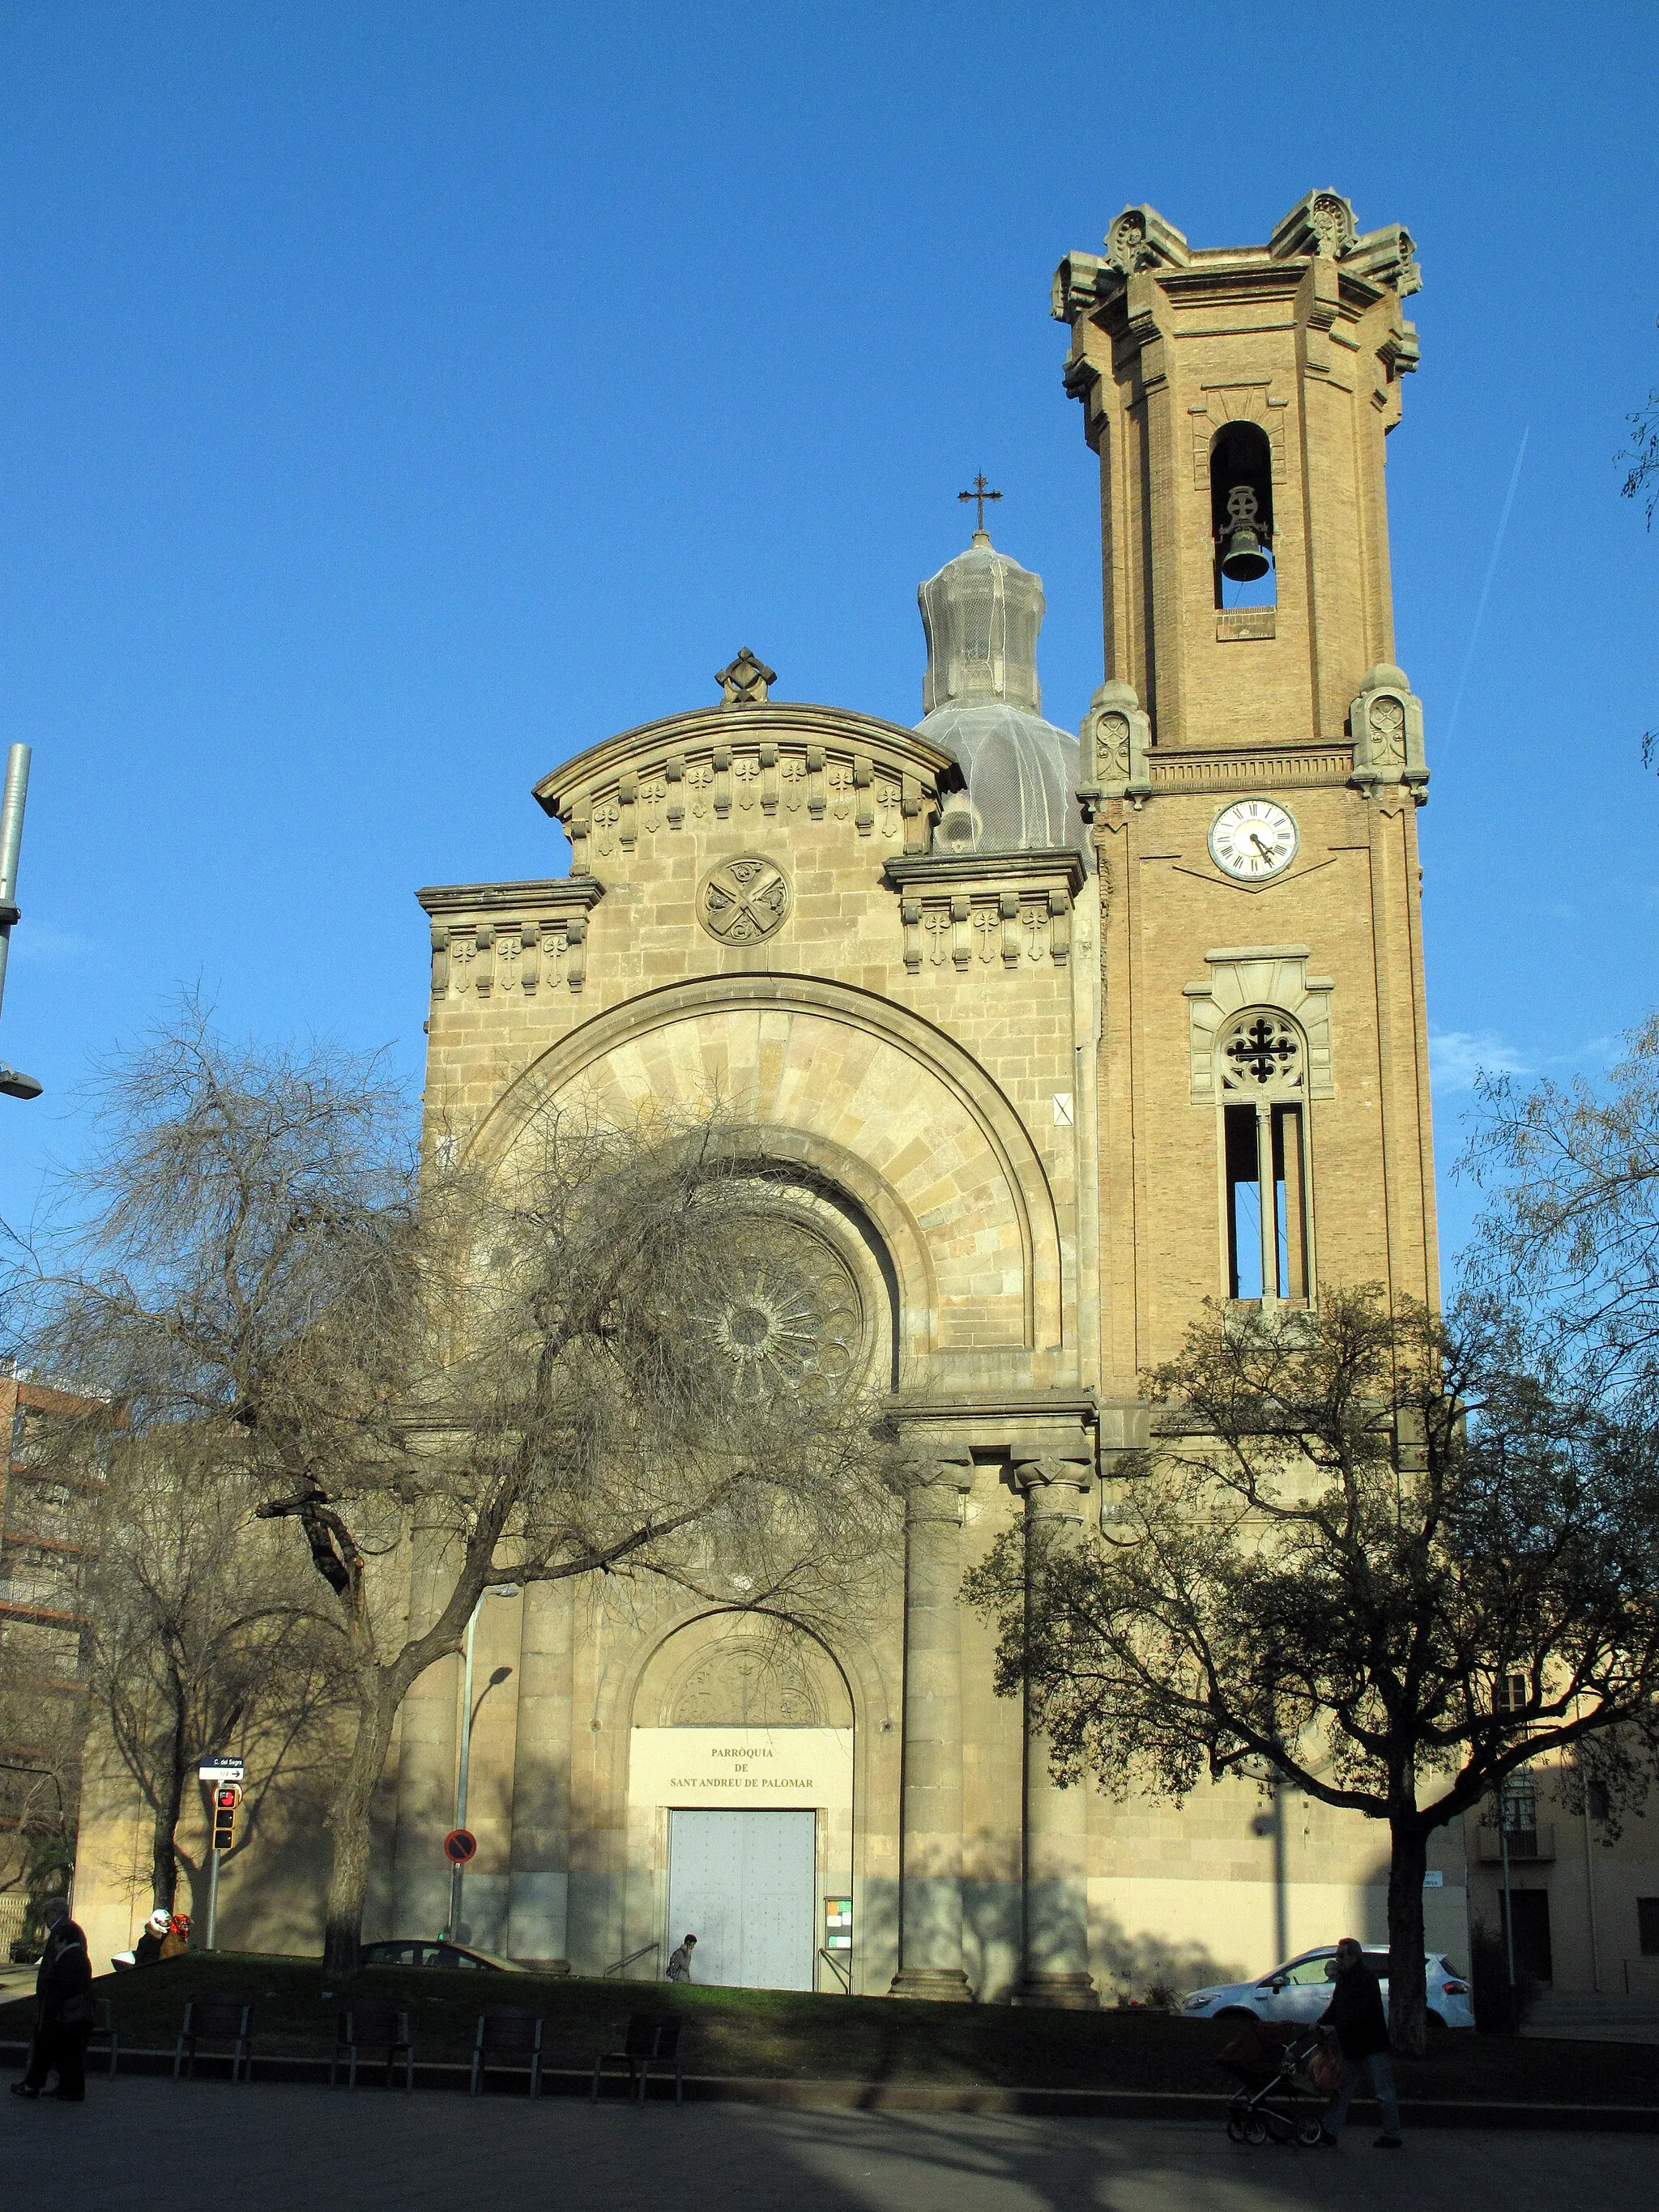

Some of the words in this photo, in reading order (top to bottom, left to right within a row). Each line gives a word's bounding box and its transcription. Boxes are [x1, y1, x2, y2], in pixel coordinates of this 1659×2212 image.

[711, 1747, 774, 1758] PARRÒQUIA
[735, 1763, 748, 1772] DE
[670, 1778, 697, 1787] SANT
[699, 1778, 742, 1787] ANDREU
[744, 1779, 758, 1787] DE
[761, 1779, 813, 1788] PALOMAR
